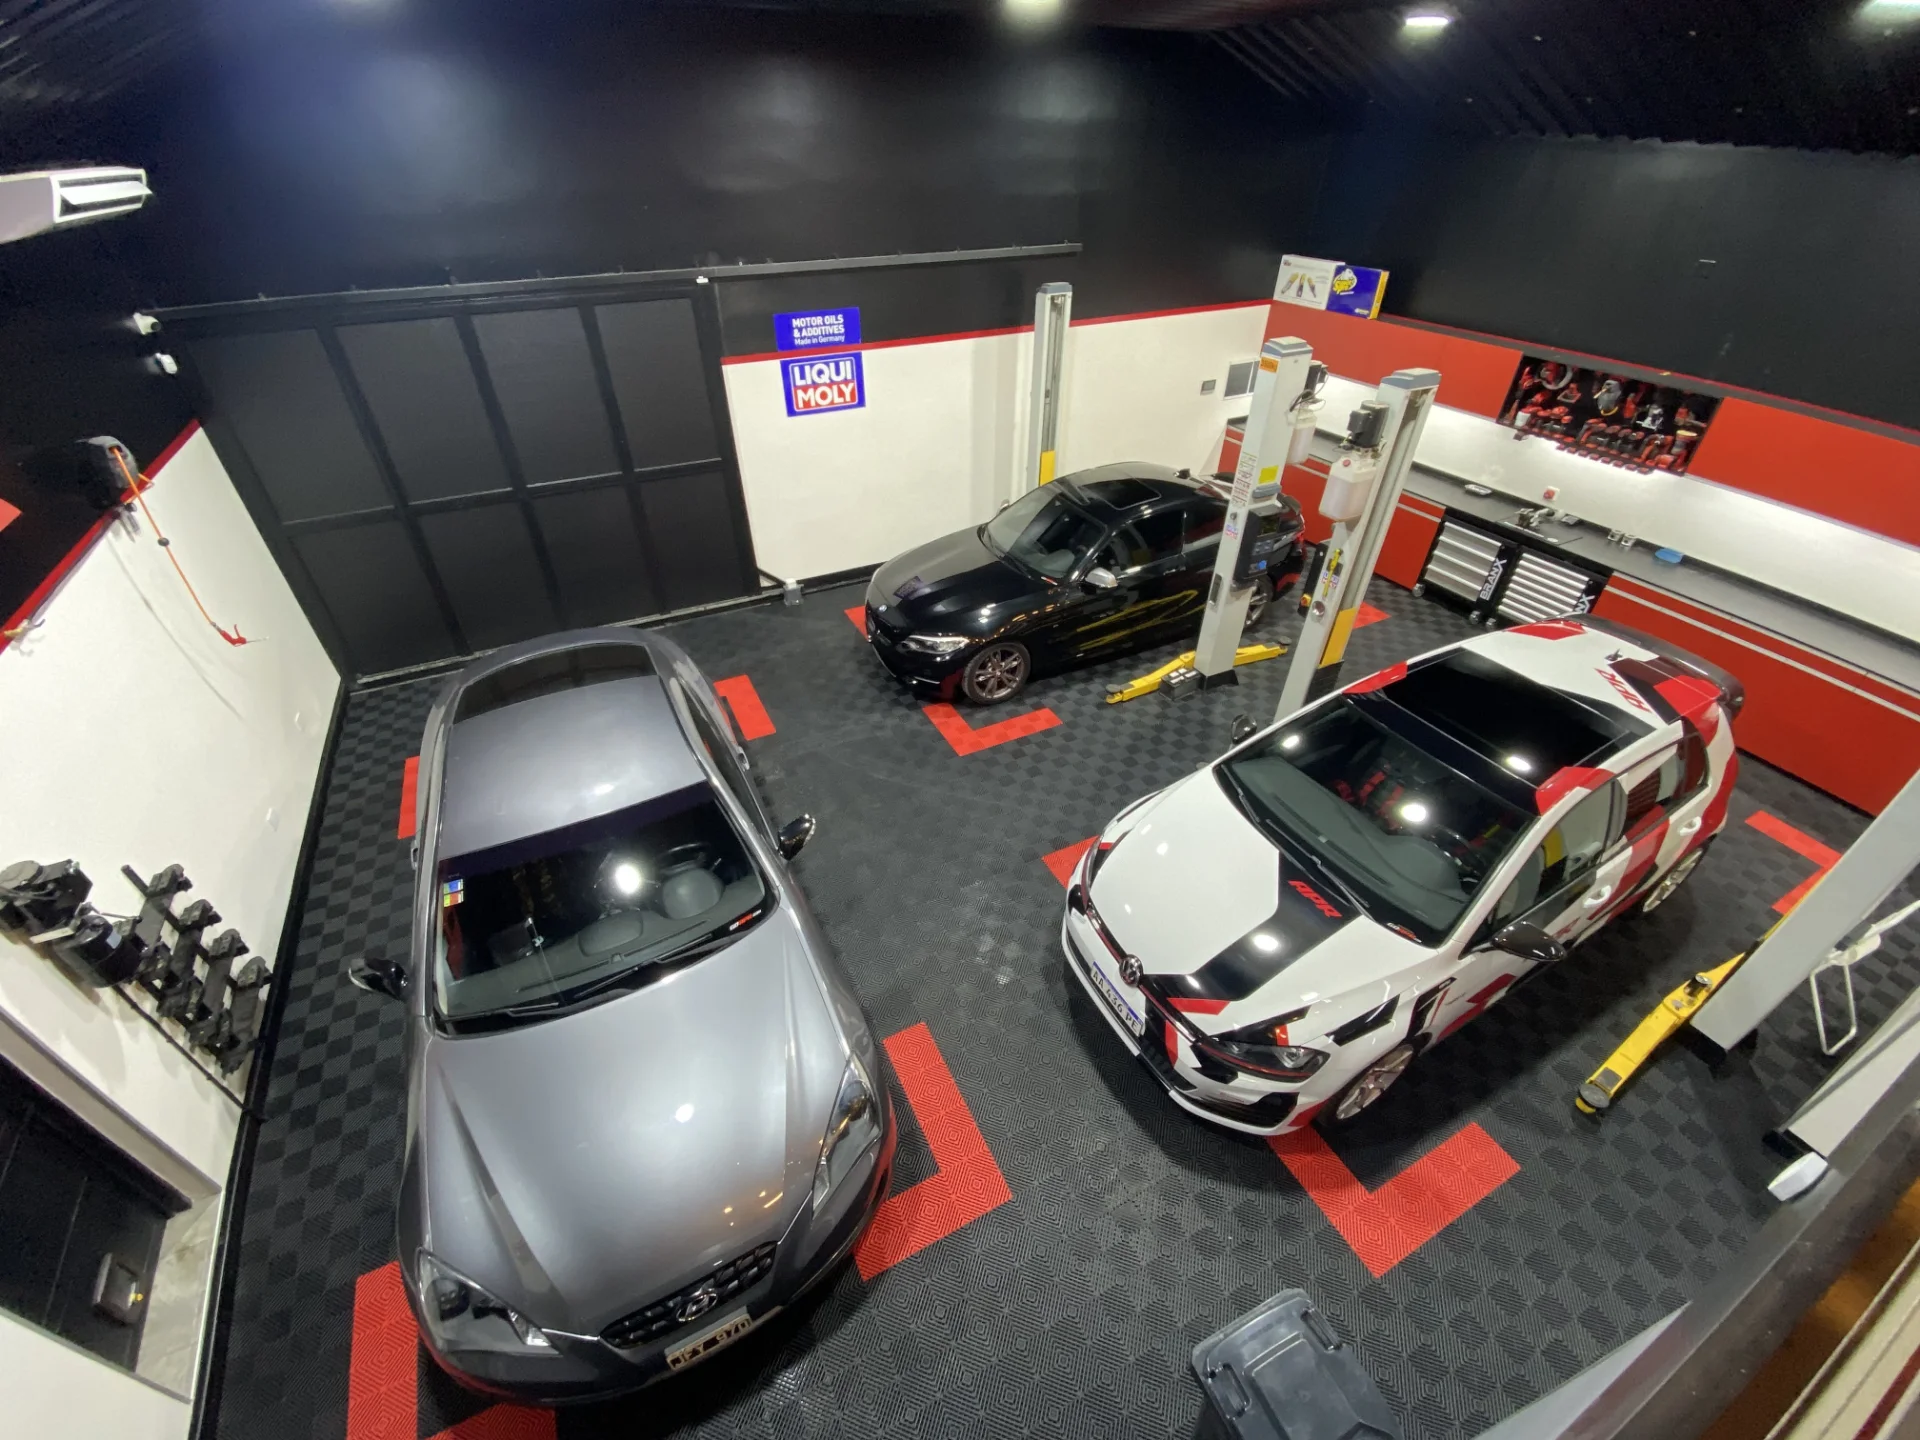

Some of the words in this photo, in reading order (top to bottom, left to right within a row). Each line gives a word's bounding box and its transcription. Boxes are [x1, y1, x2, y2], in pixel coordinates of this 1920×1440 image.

[792, 316, 823, 328] MOTOR
[824, 314, 844, 325] OILS
[794, 328, 801, 338] &
[801, 325, 845, 337] ADDITIVES
[818, 335, 845, 343] Germany
[793, 360, 853, 386] LIQUI
[796, 382, 855, 409] MOLY
[1479, 557, 1508, 601] BRANX
[1093, 969, 1104, 989] AA
